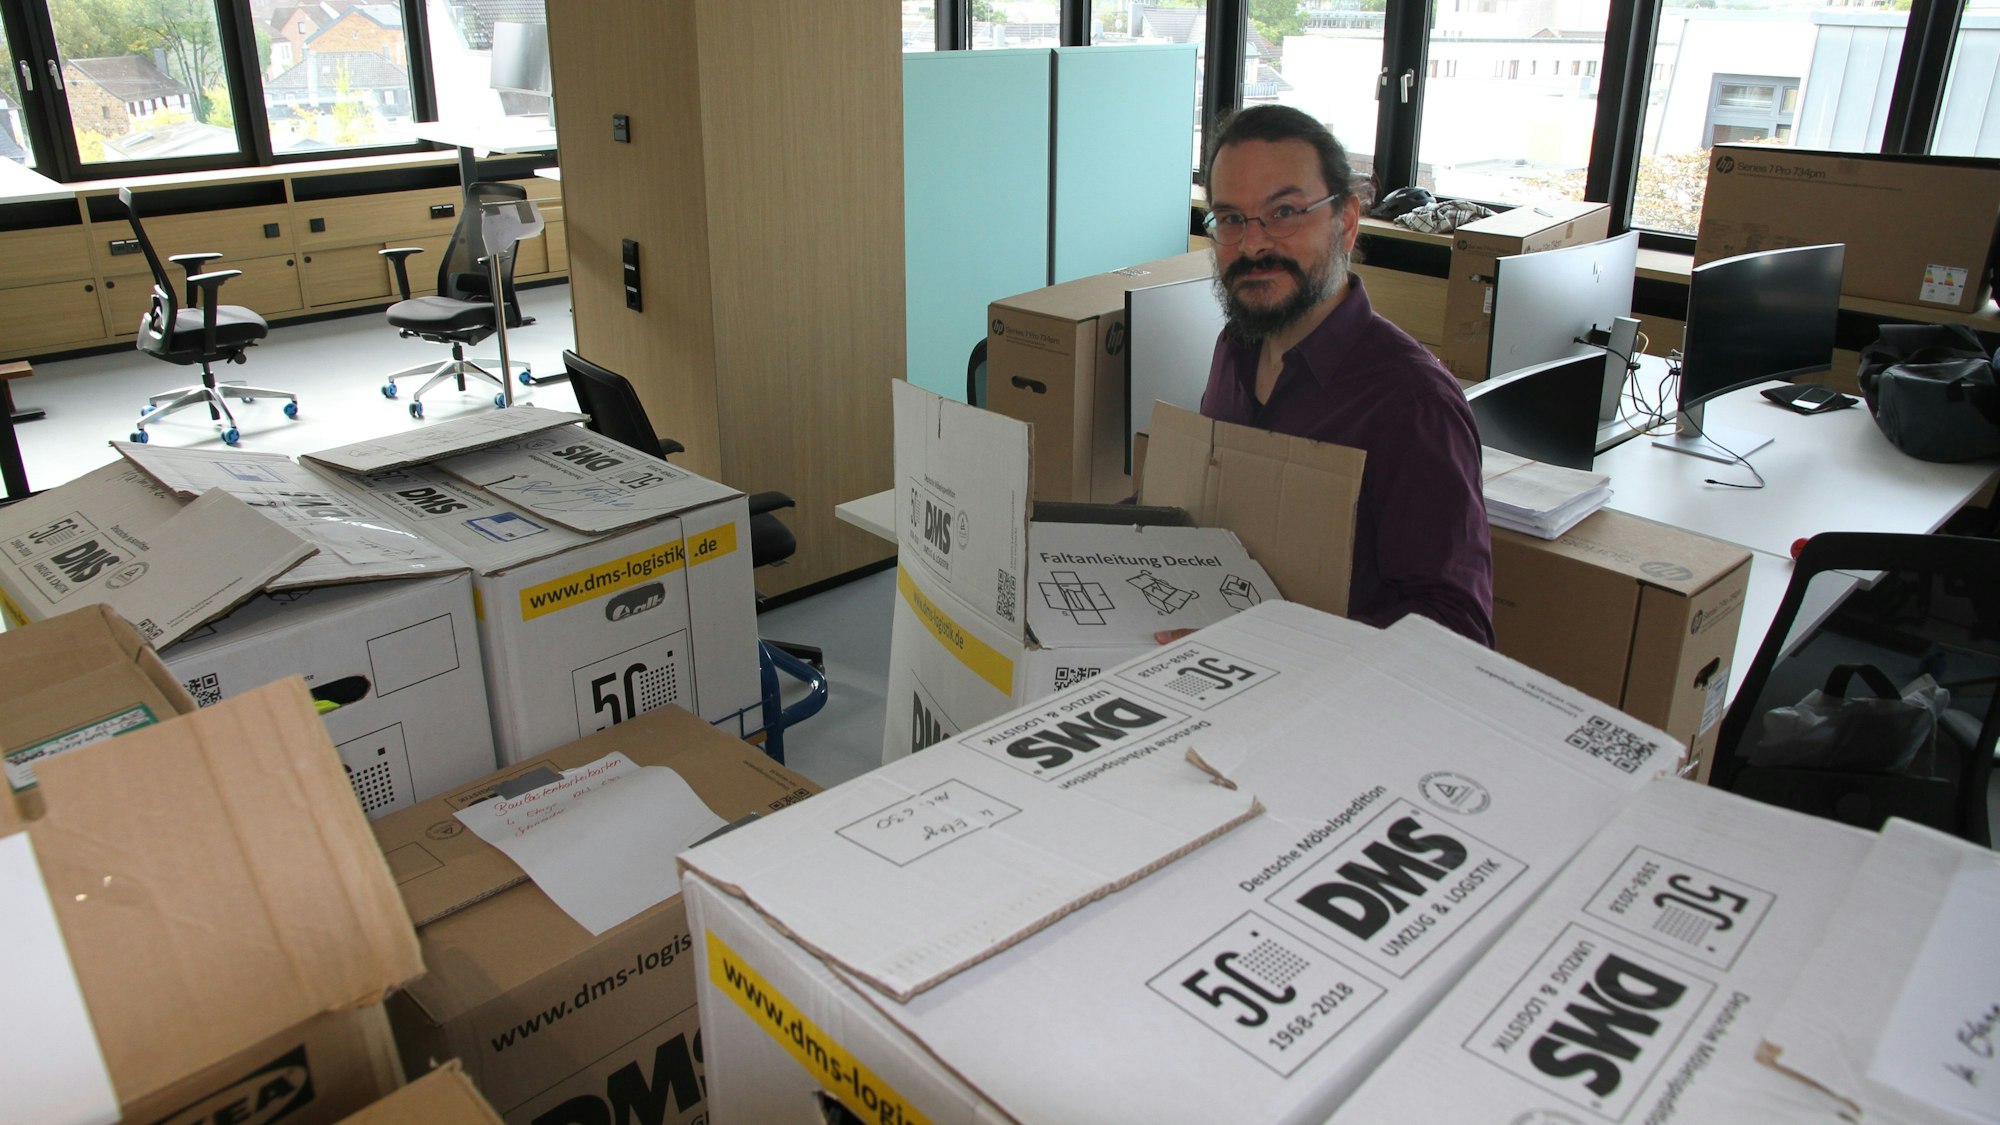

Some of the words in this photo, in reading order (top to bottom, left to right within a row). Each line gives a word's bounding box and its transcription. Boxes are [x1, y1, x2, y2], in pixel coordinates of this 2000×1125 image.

[1716, 155, 1735, 174] hp
[1738, 161, 1766, 174] Series
[1766, 164, 1775, 174] 7
[1775, 165, 1791, 176] Pro
[992, 319, 1005, 335] hp
[924, 500, 951, 554] DMS
[1040, 552, 1162, 568] Faltanleitung
[1163, 555, 1222, 567] Deckel
[1138, 648, 1200, 679] 1968-2018
[1060, 689, 1111, 712] UMZUG
[983, 717, 1046, 747] LOGISTIK
[1006, 697, 1167, 769] DMS
[1155, 720, 1212, 748] Deutsche
[1057, 743, 1159, 792] Möbelspedition
[1240, 846, 1302, 894] Deutsche
[1298, 783, 1388, 855] Möbelspedition
[1296, 815, 1468, 942] DMS
[1609, 860, 1661, 915] 1968-2018
[1381, 913, 1436, 959] UMZUG
[1435, 900, 1449, 915] &
[1448, 858, 1502, 905] LOGISTIK
[1551, 939, 1596, 986] UMZUG
[490, 933, 692, 1054] www.dms-logis
[1268, 982, 1356, 1052] 1968-2018
[1540, 983, 1559, 997] &
[723, 956, 916, 1125] www.dms-logi
[1492, 995, 1548, 1054] LOGISTIK
[1529, 953, 1688, 1098] DMS
